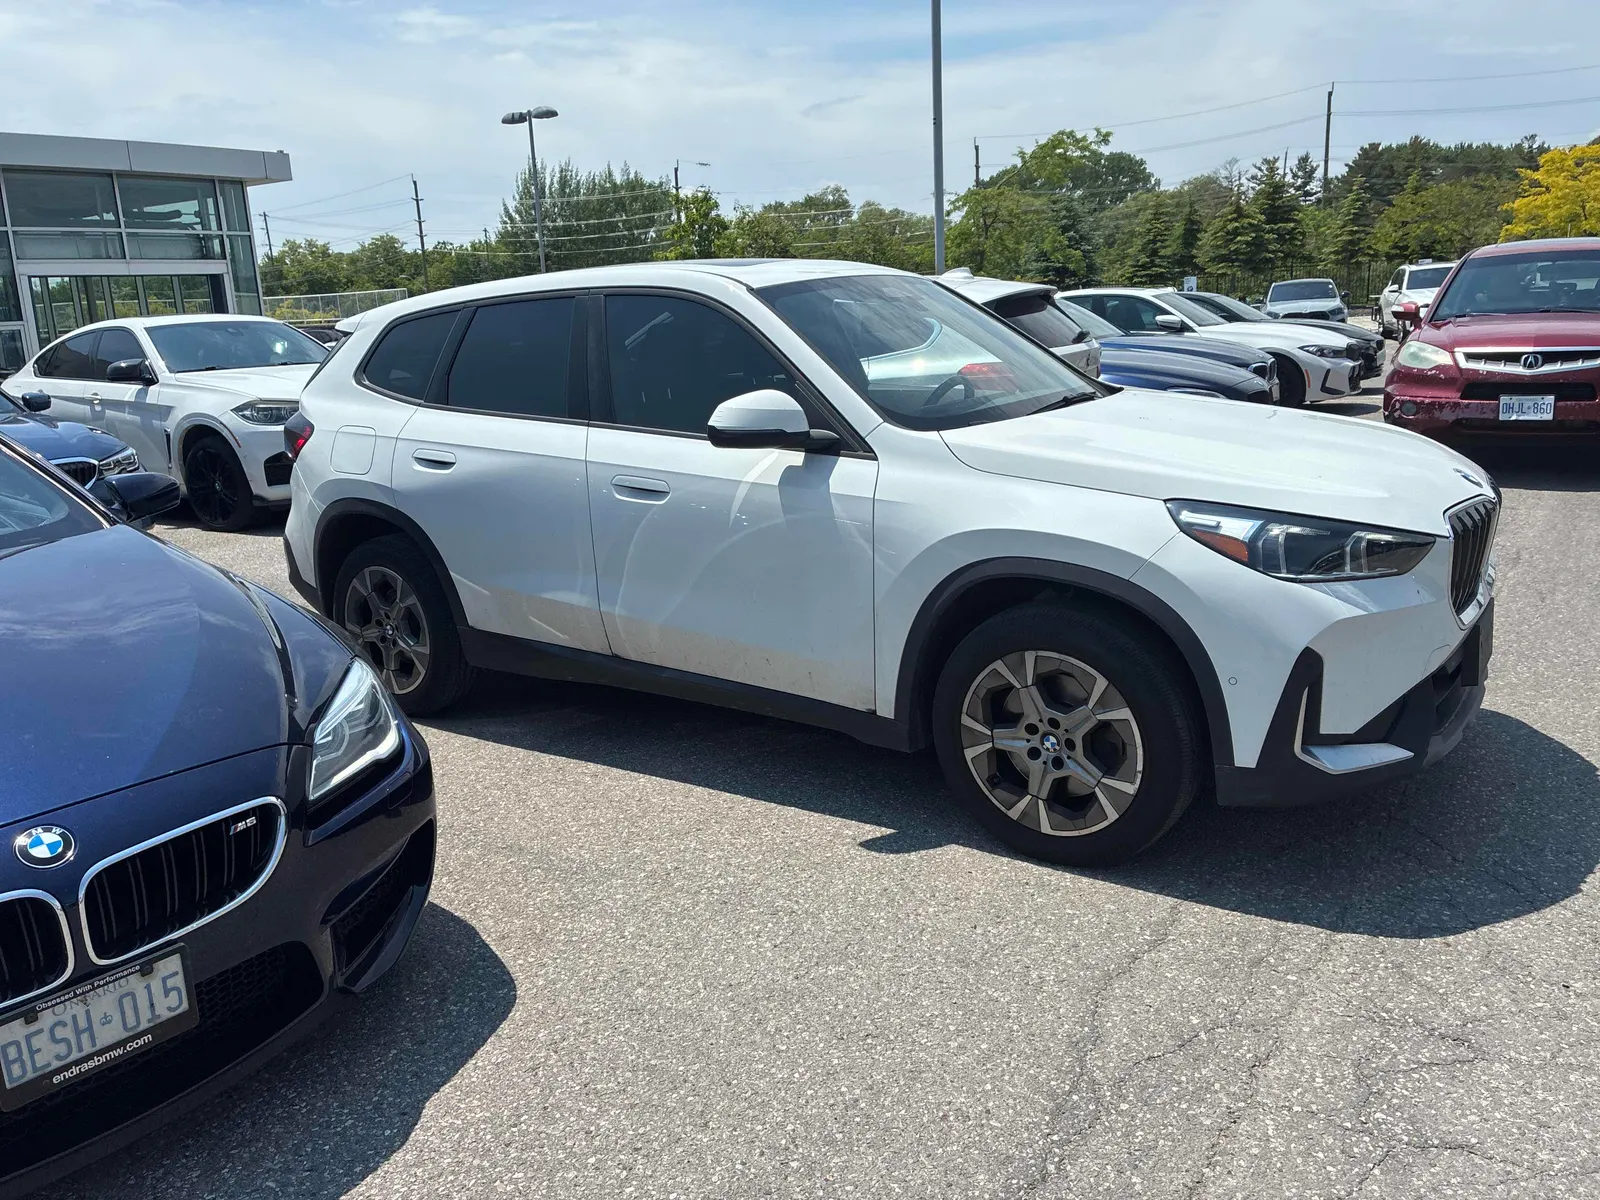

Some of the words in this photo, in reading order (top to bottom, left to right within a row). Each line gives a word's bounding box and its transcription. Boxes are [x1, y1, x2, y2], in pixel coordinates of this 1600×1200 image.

[1532, 402, 1552, 414] 860
[36, 991, 75, 1011] Obsessed
[76, 984, 93, 995] With
[94, 965, 140, 987] Performance
[52, 977, 129, 1016] ONARIO
[1, 1008, 97, 1085] BESH
[118, 970, 184, 1033] 015
[52, 1033, 153, 1085] endrasbmw.com
